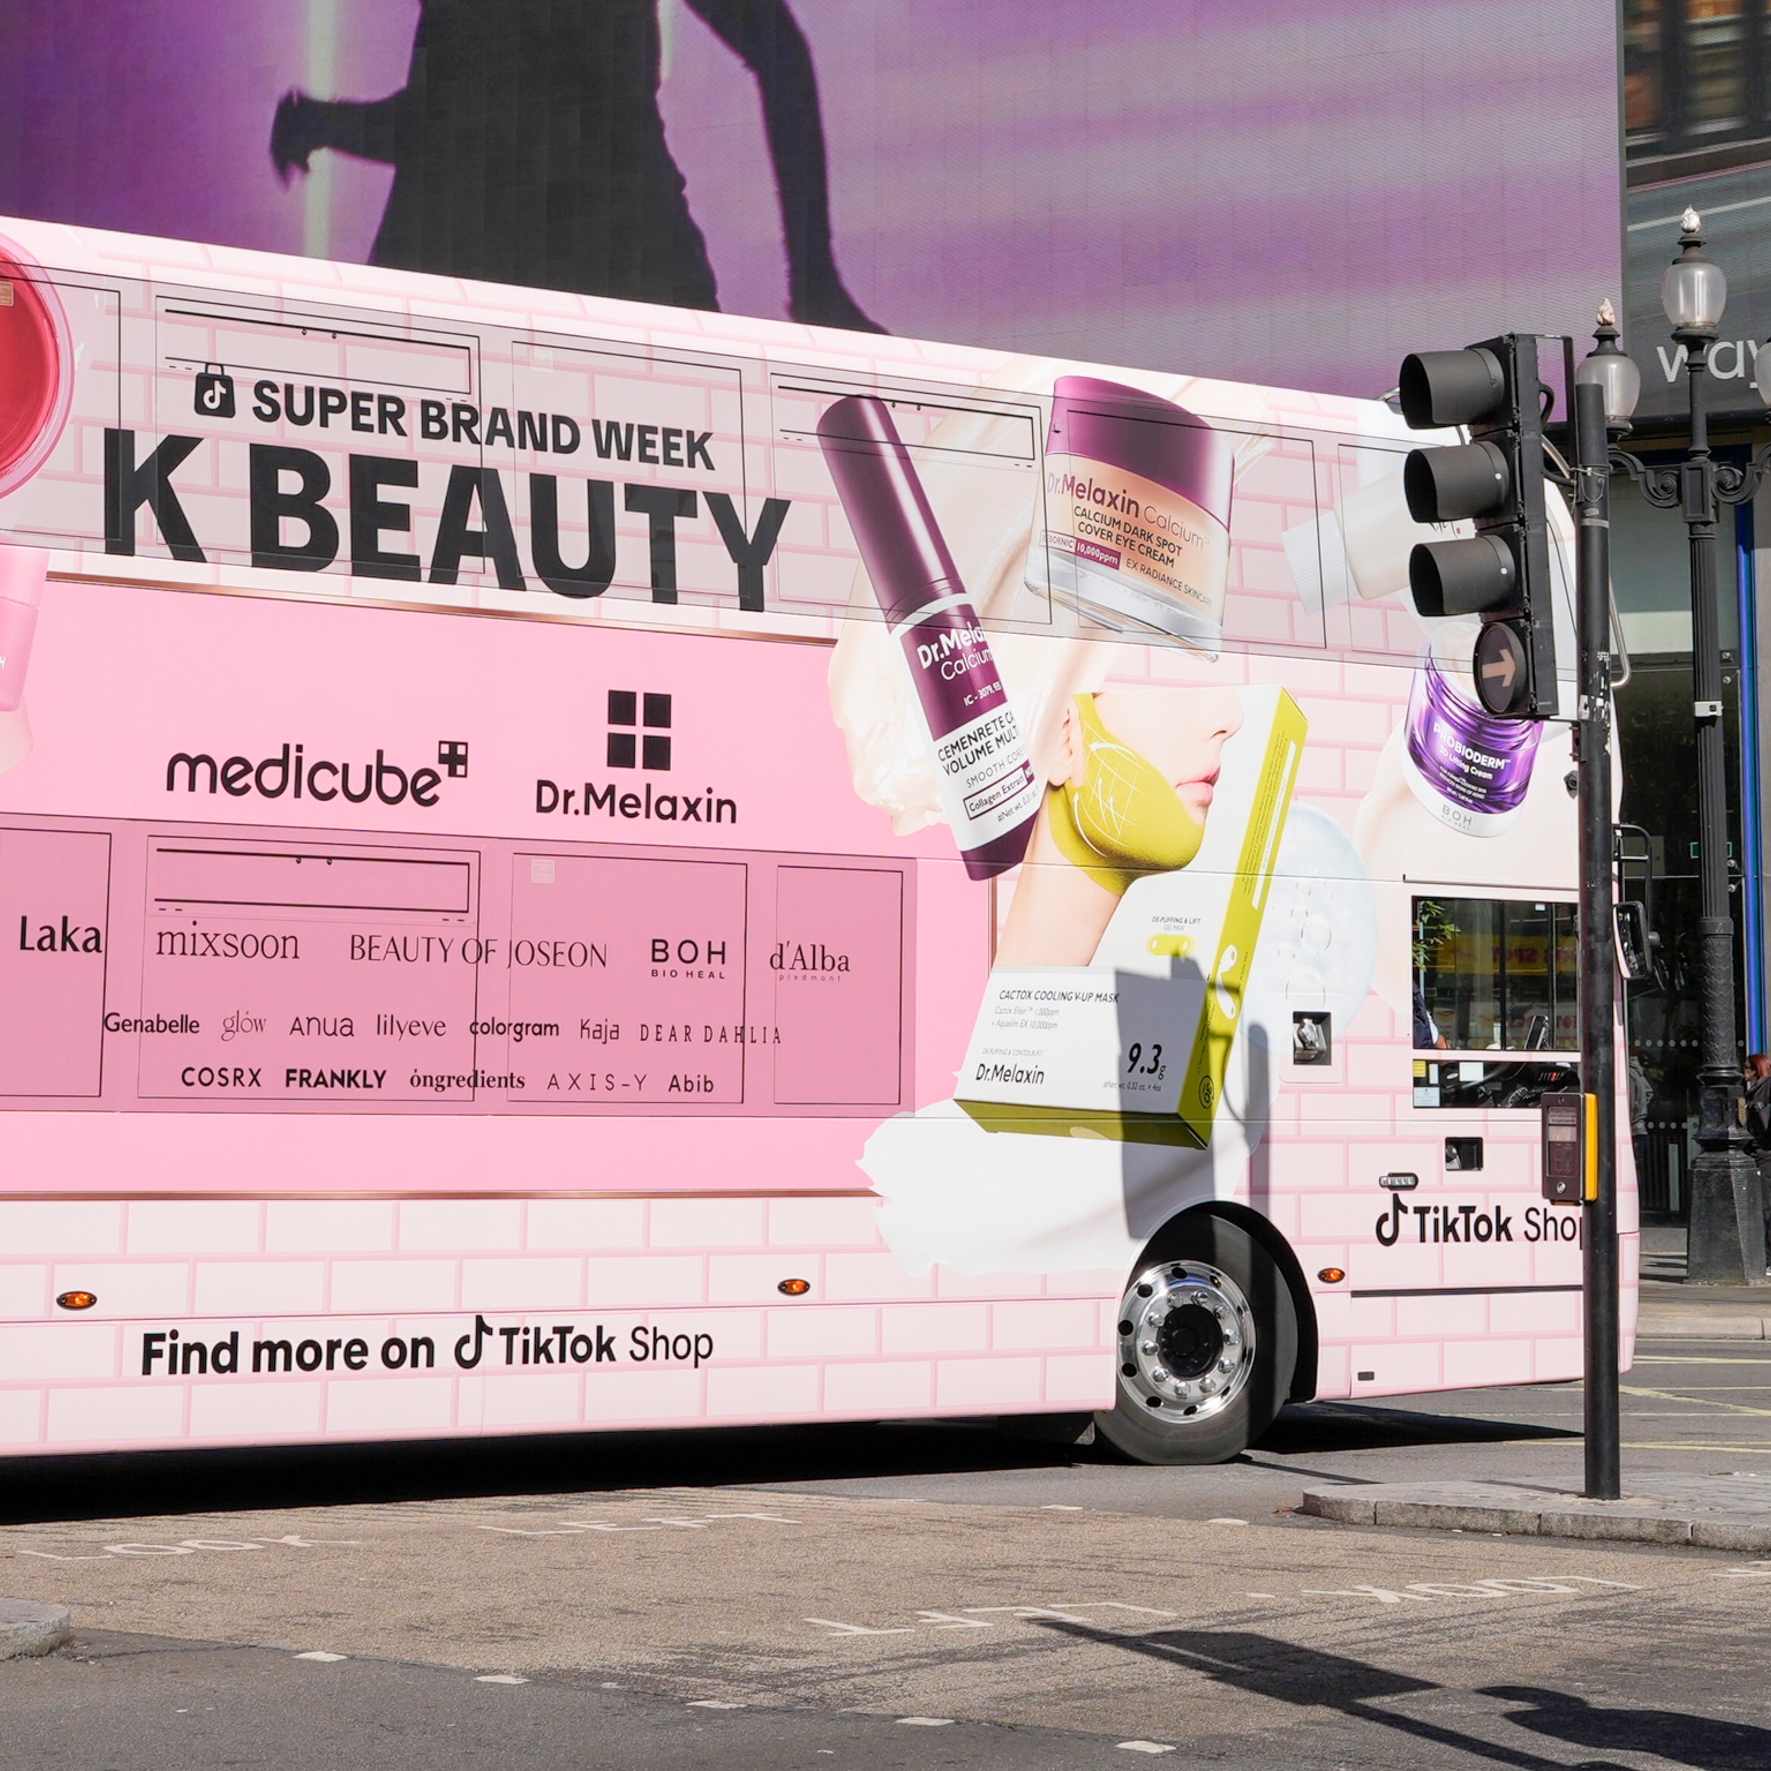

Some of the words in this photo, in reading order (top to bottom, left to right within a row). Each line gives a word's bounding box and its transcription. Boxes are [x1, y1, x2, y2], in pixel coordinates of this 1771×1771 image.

[252, 378, 408, 437] SUPER
[421, 398, 580, 454] BRAND
[592, 418, 716, 471] WEEK
[1047, 472, 1140, 518] Dr.Melaxin
[105, 428, 208, 563] K
[249, 442, 792, 612] BEAUTY
[1074, 506, 1121, 530] CALCIUM
[1123, 523, 1154, 545] DARK
[1156, 535, 1183, 557] SPOT
[1078, 521, 1113, 543] COVER
[1115, 533, 1136, 552] EYE
[1137, 544, 1175, 568] CREAM
[166, 743, 443, 807] medicube
[536, 778, 738, 824] Dr.Melaxin
[19, 915, 103, 953] Laka
[156, 919, 300, 960] mixsoon
[350, 934, 454, 964] BEAUTY
[461, 938, 498, 965] OF
[507, 940, 607, 969] JOSEON
[651, 938, 726, 965] BOH
[770, 941, 850, 972] d'Alba
[651, 969, 678, 978] BIO
[686, 971, 725, 979] HEAL
[999, 989, 1032, 1000] CACTOX
[1034, 990, 1073, 1002] COOLING
[1075, 992, 1093, 1002] V-UP
[1096, 993, 1120, 1004] MASK
[104, 1012, 200, 1035] Genabelle
[289, 1015, 355, 1037] Anua
[376, 1013, 447, 1042] lilyeve
[469, 1016, 560, 1043] colorgram
[580, 1018, 619, 1044] Kaja
[640, 1024, 692, 1042] DEAR
[704, 1026, 781, 1044] DAHLIA
[182, 1066, 262, 1088] COSRX
[285, 1068, 387, 1089] FRANKLY
[668, 1074, 714, 1093] Abib
[976, 1063, 1044, 1085] Dr.Melaxin
[1413, 1205, 1513, 1244] TikTok
[142, 1329, 239, 1376] Find
[251, 1338, 368, 1374] more
[380, 1336, 435, 1369] on
[499, 1324, 617, 1365] TikTok
[628, 1326, 714, 1369] Shop
